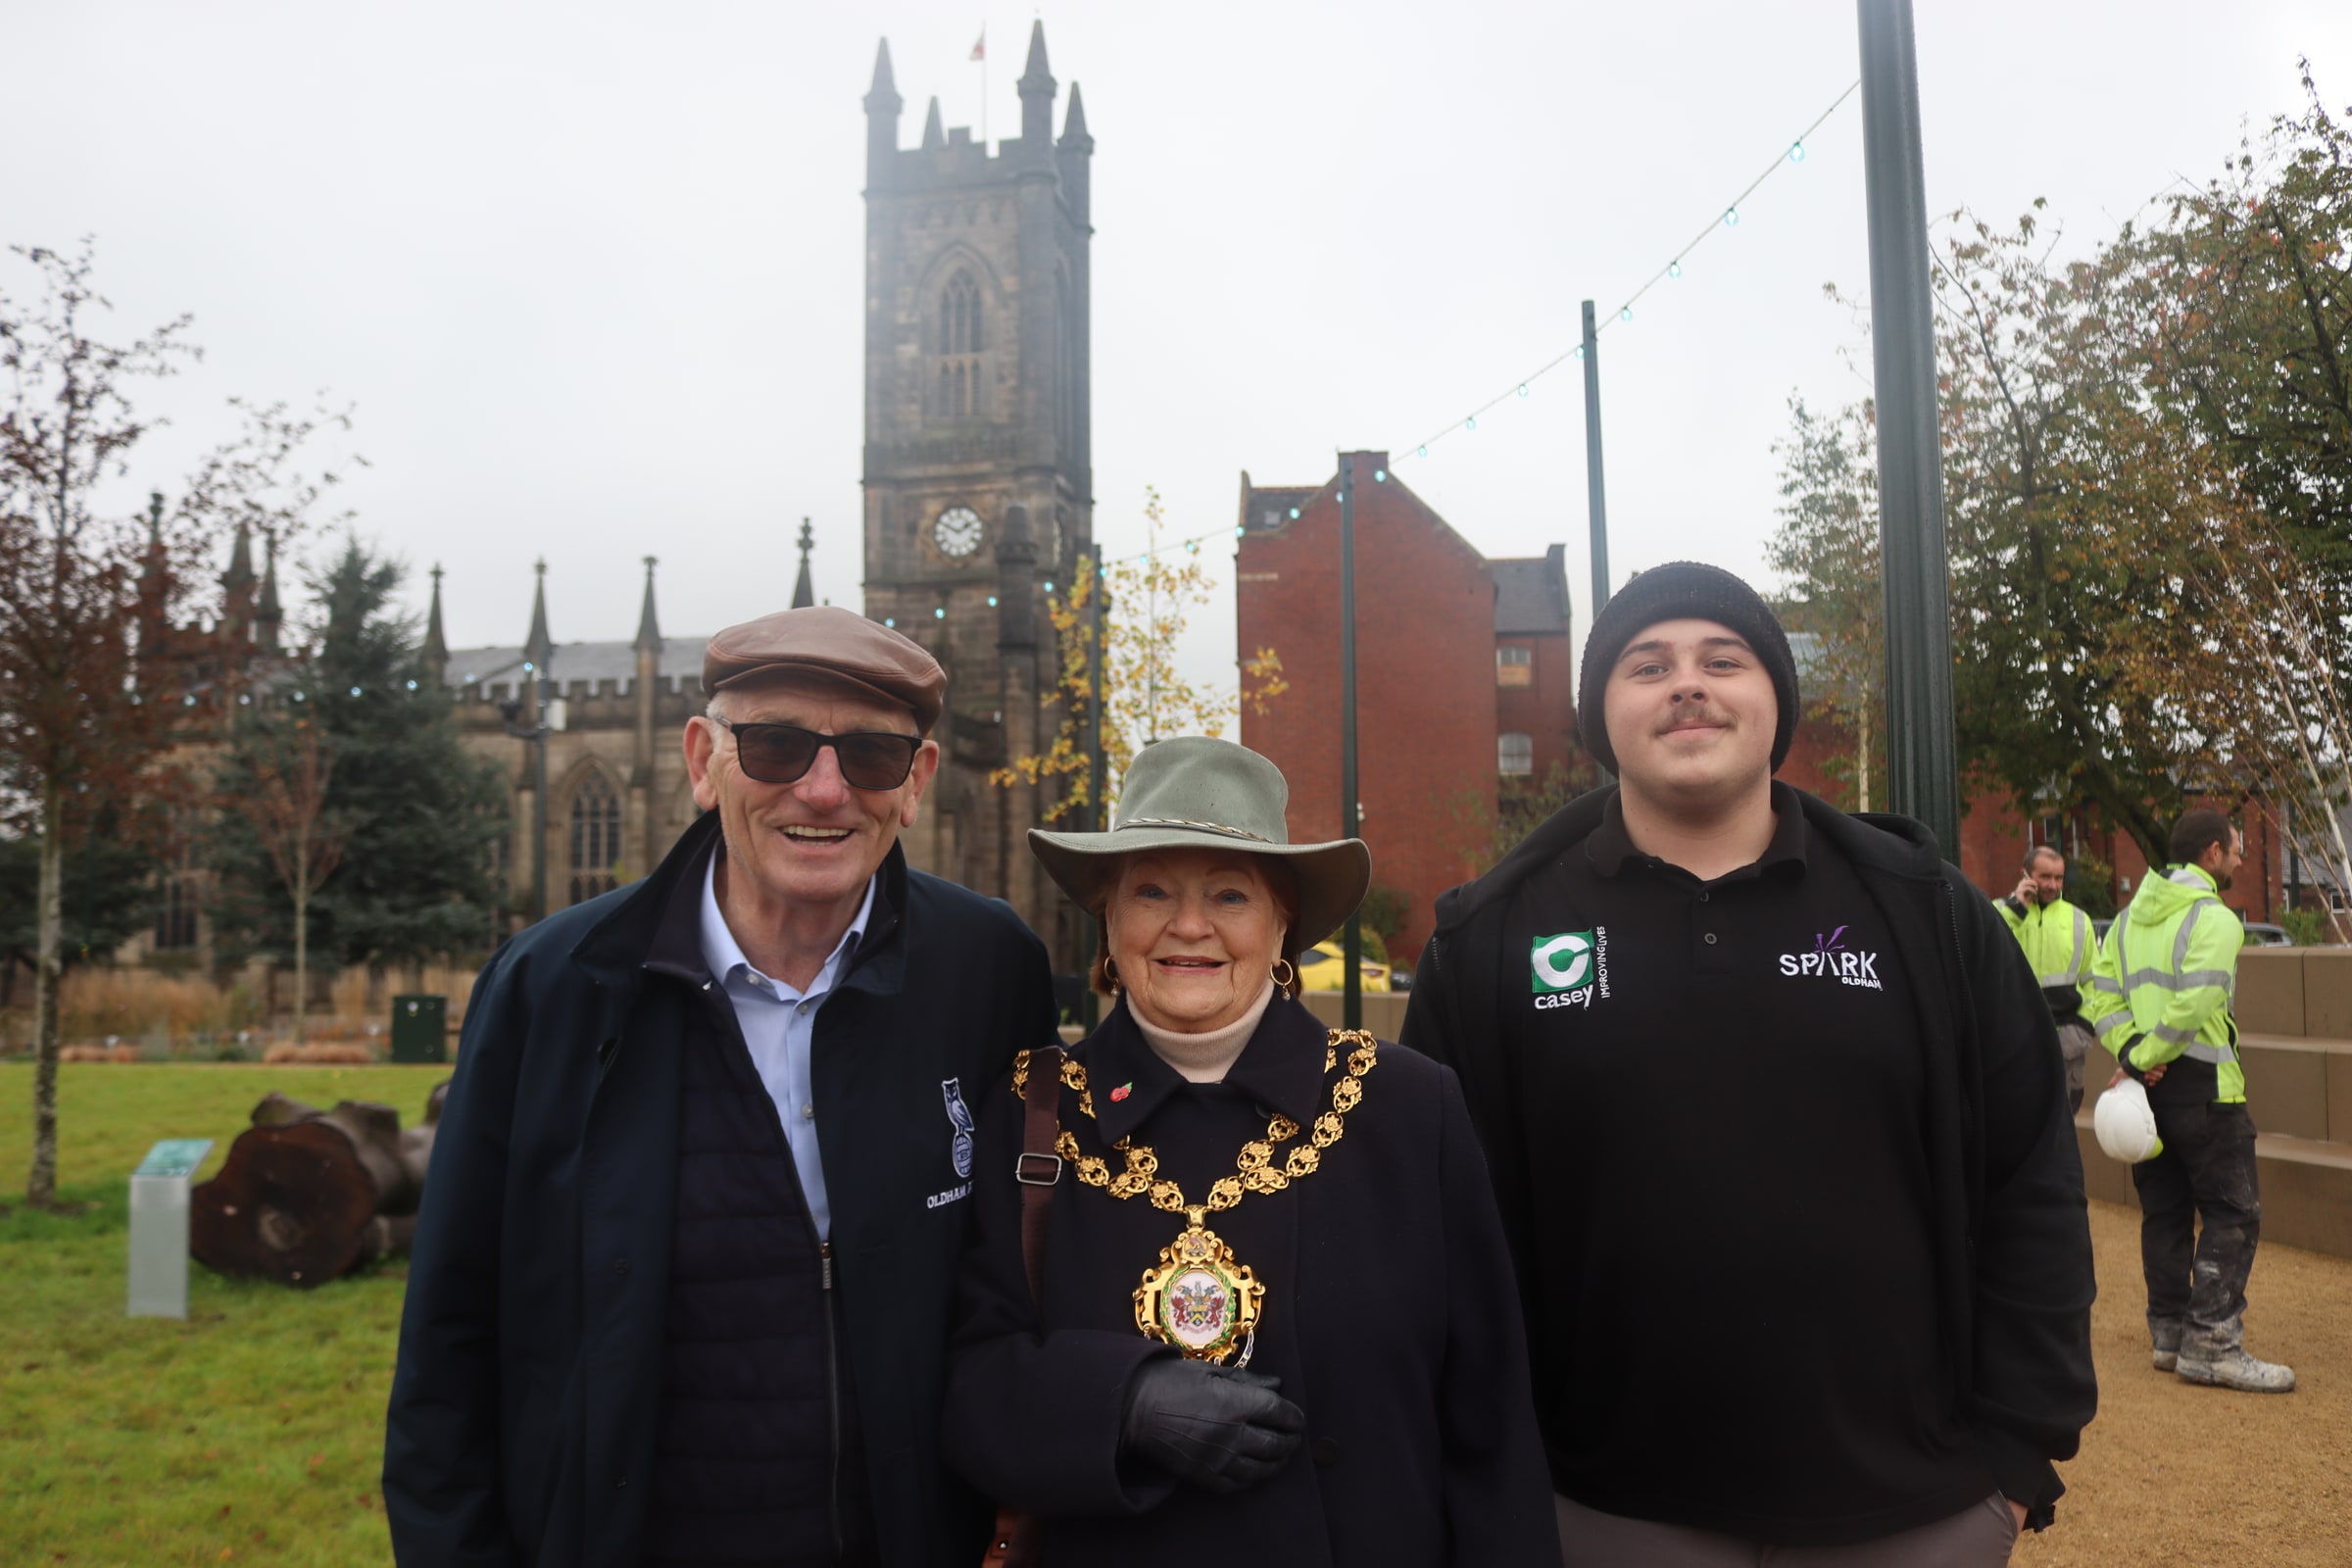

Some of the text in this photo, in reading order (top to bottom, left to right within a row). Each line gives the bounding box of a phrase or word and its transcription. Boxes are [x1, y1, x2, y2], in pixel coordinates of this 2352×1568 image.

[1596, 946, 1610, 999] IMPROVING
[1779, 951, 1878, 979] SPARK
[1841, 976, 1883, 991] OLDHAM
[1534, 984, 1593, 1010] casey
[926, 1184, 967, 1209] OLDHAM
